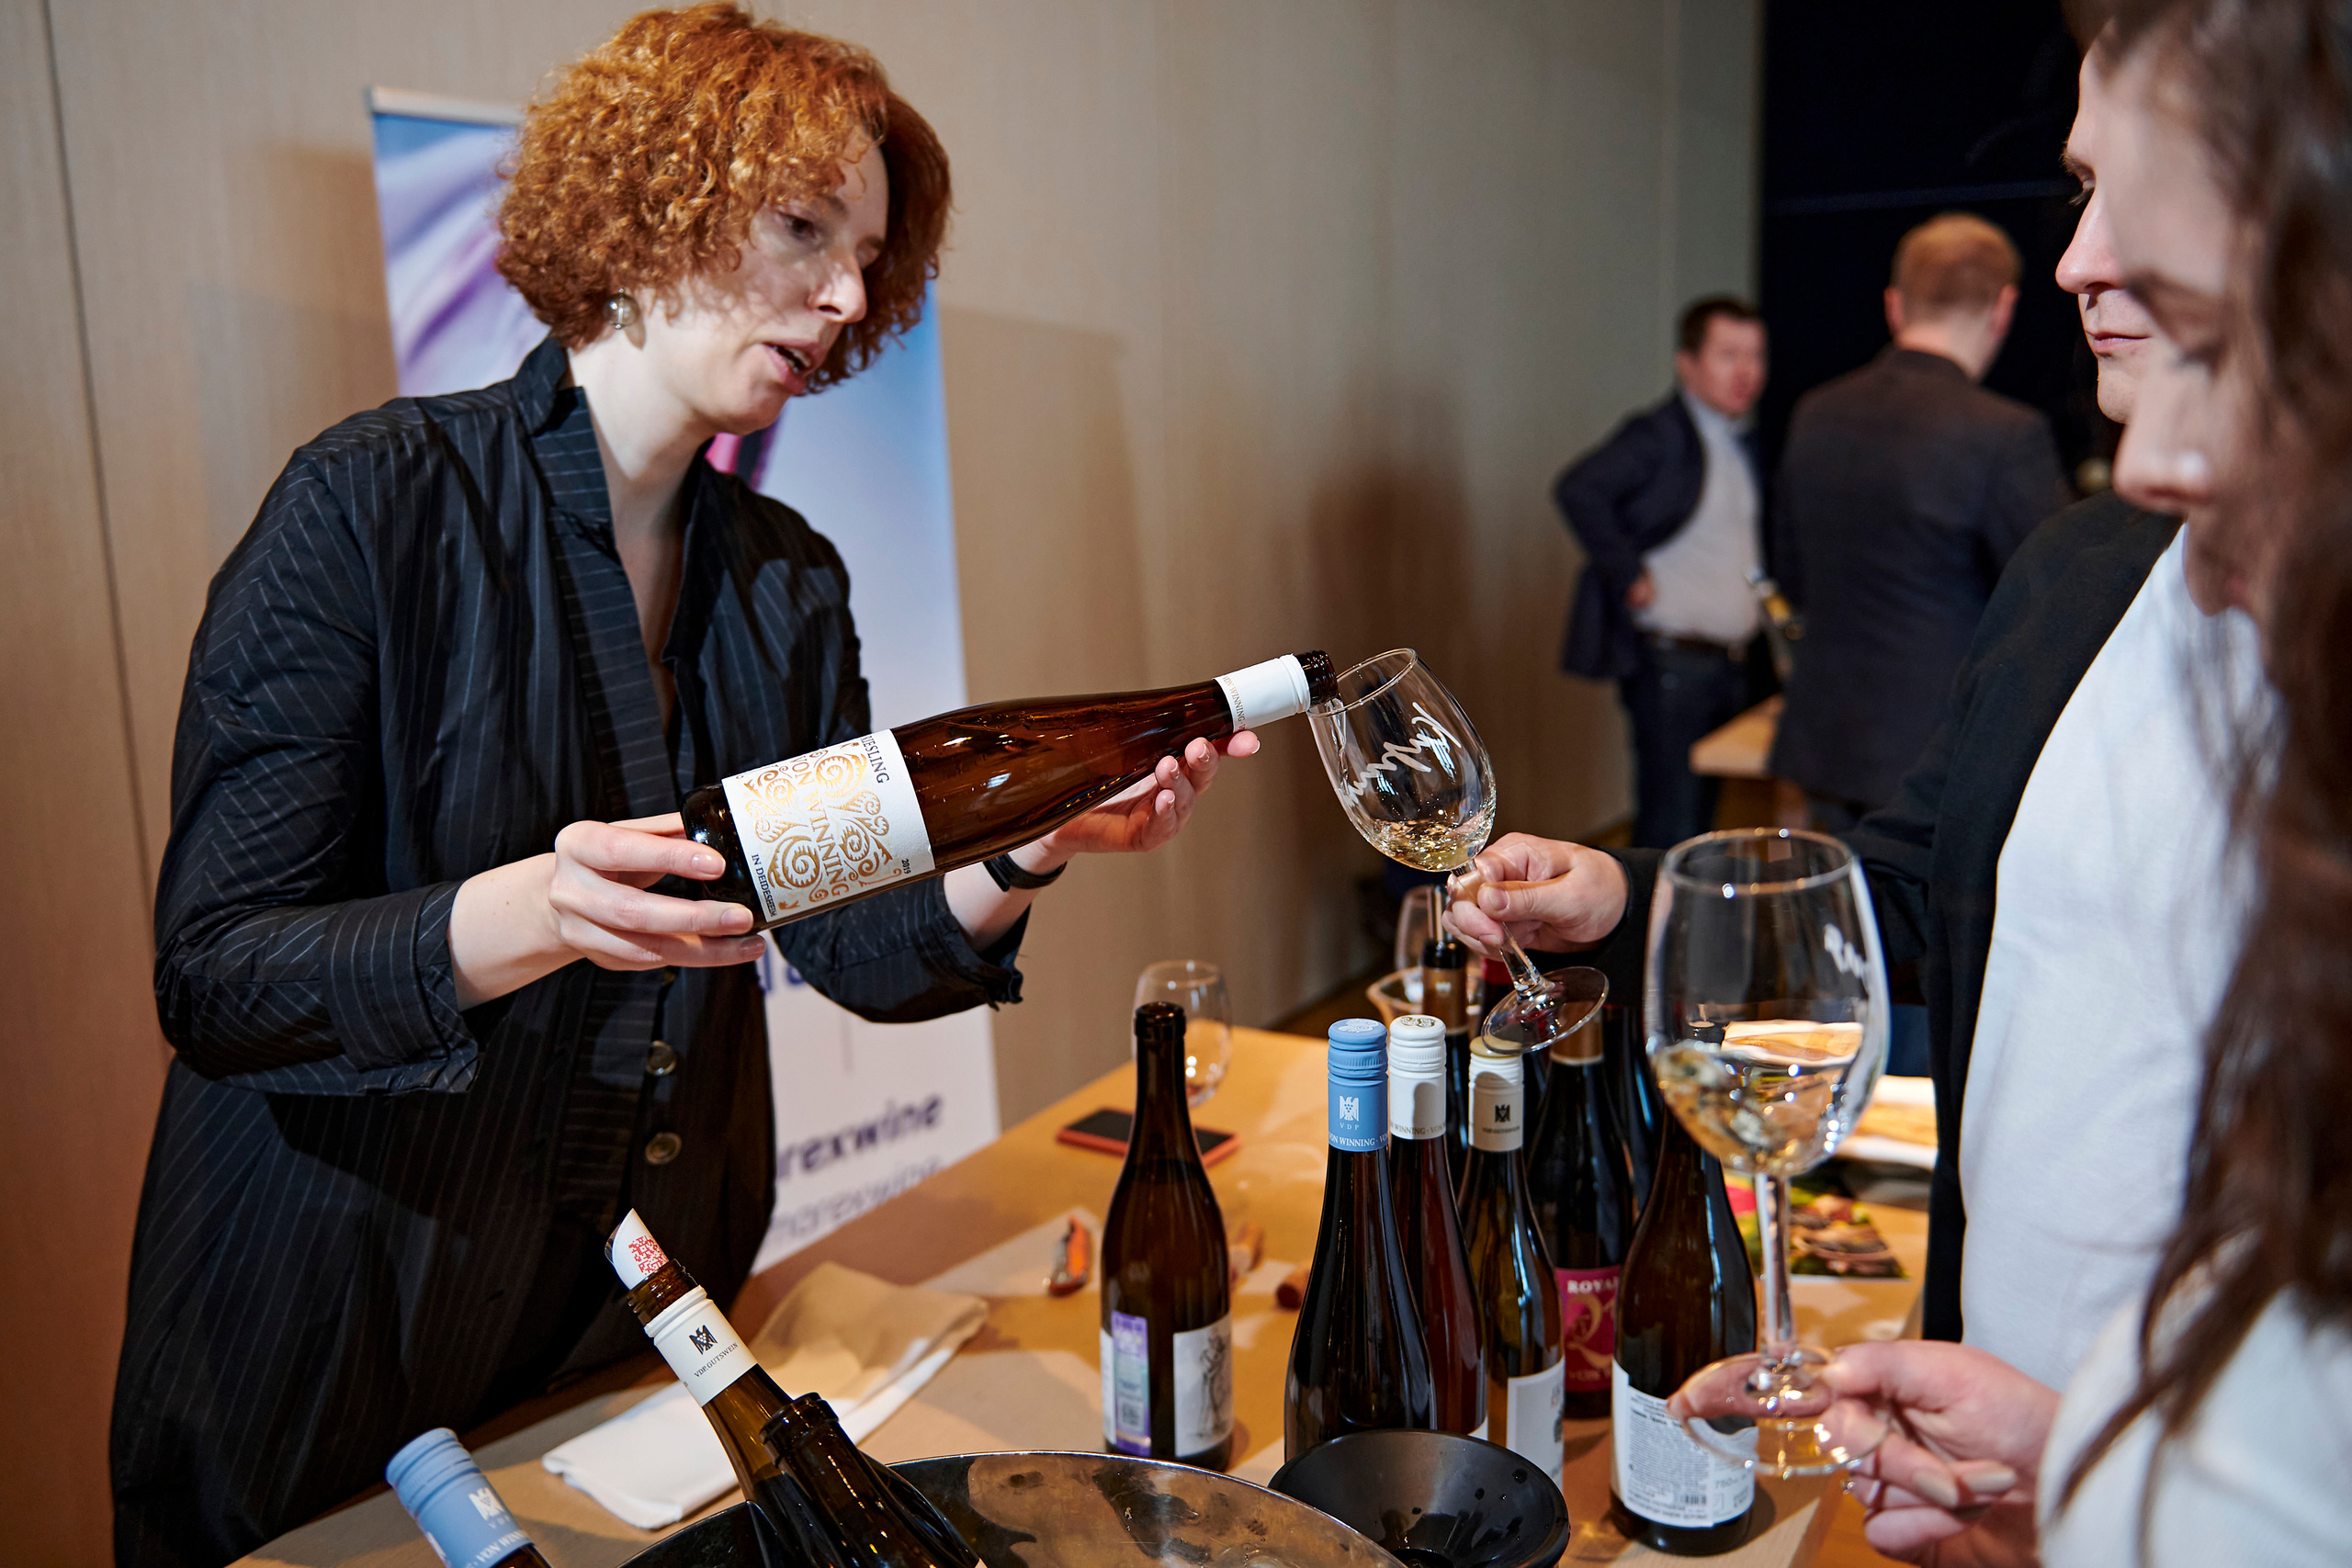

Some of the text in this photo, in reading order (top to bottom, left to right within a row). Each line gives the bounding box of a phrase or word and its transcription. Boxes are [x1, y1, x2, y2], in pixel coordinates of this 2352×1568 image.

[1230, 687, 1245, 722] WINNING
[861, 736, 889, 784] RIESLING
[790, 755, 850, 897] VON WINNING
[752, 853, 762, 865] IN
[901, 858, 911, 874] 2019
[1340, 1122, 1360, 1131] VDP
[1394, 1123, 1426, 1135] WINNING
[1430, 1125, 1442, 1134] VON
[1339, 1136, 1375, 1147] WINNING
[694, 1342, 739, 1378] VDP.GUTSWEIN
[475, 1541, 502, 1563] VON
